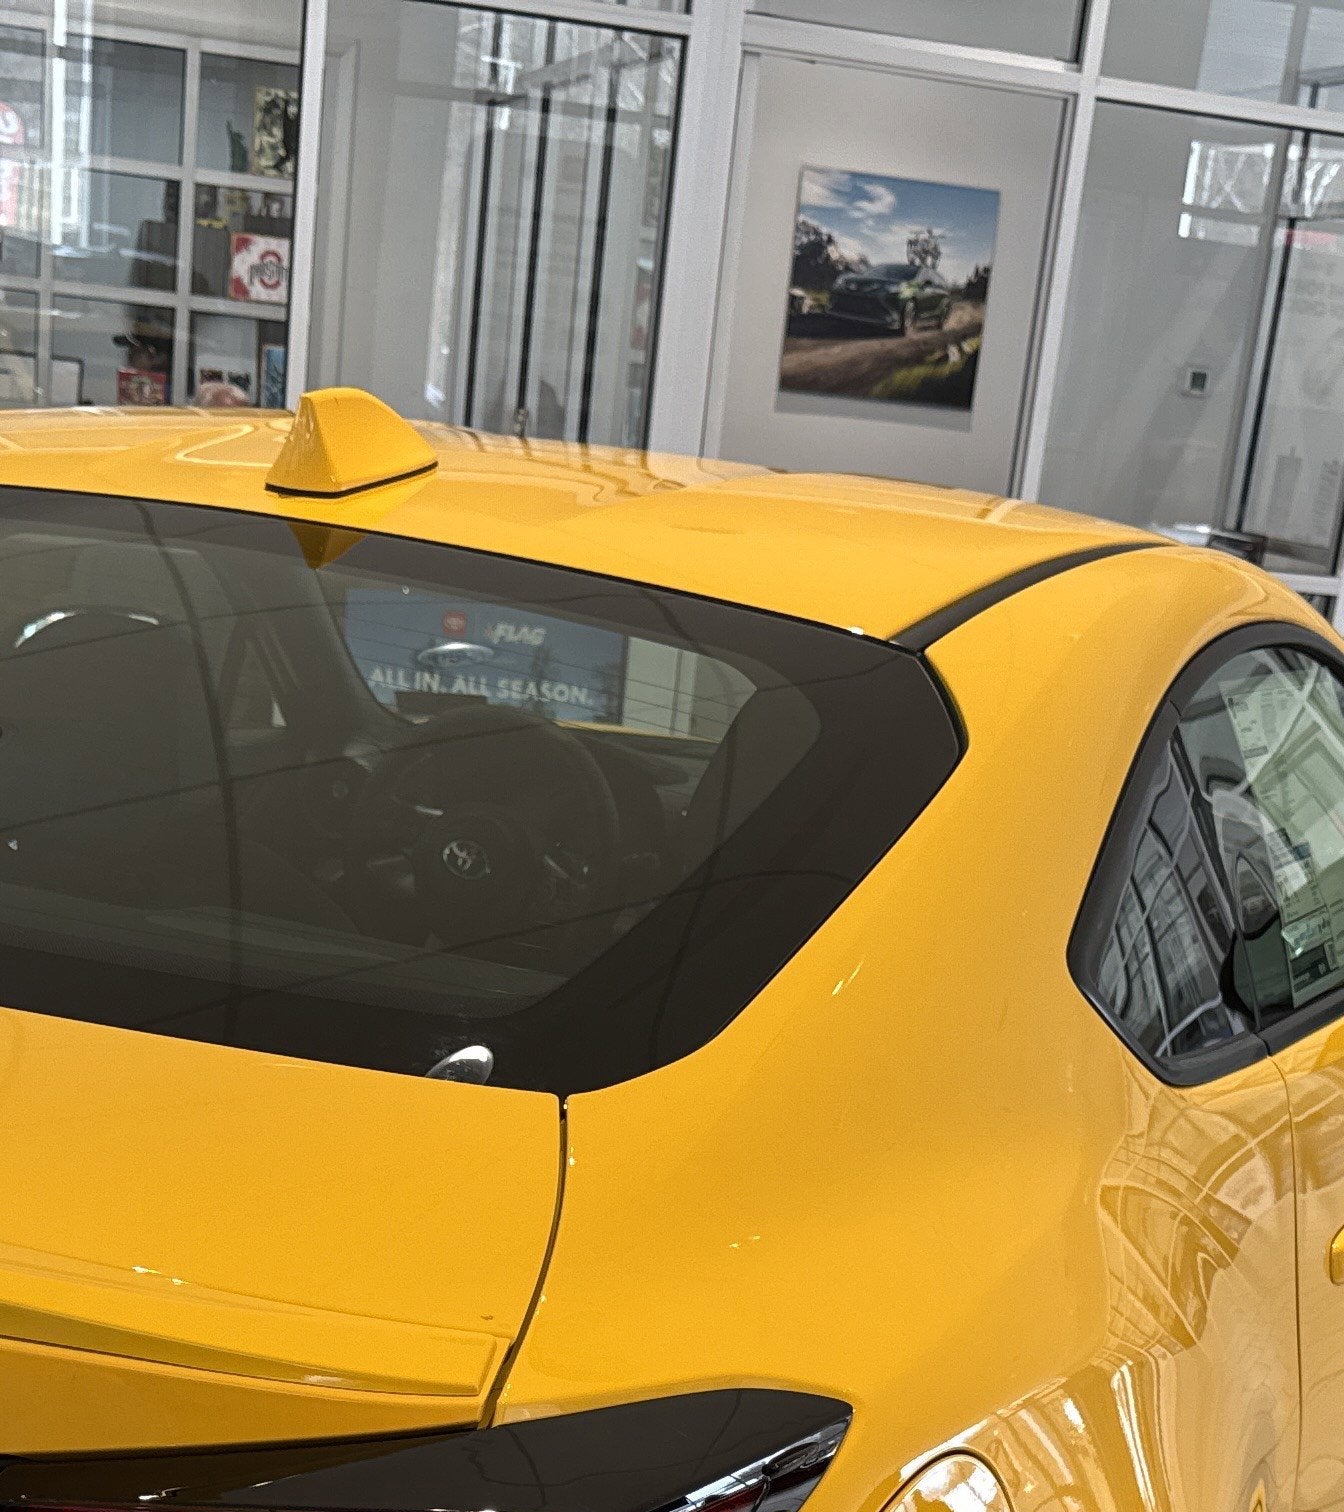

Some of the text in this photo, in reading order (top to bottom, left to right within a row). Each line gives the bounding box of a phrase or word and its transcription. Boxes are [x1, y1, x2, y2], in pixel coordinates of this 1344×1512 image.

[493, 623, 546, 646] FLAG
[368, 664, 409, 692] ALL
[453, 674, 490, 698] ALL
